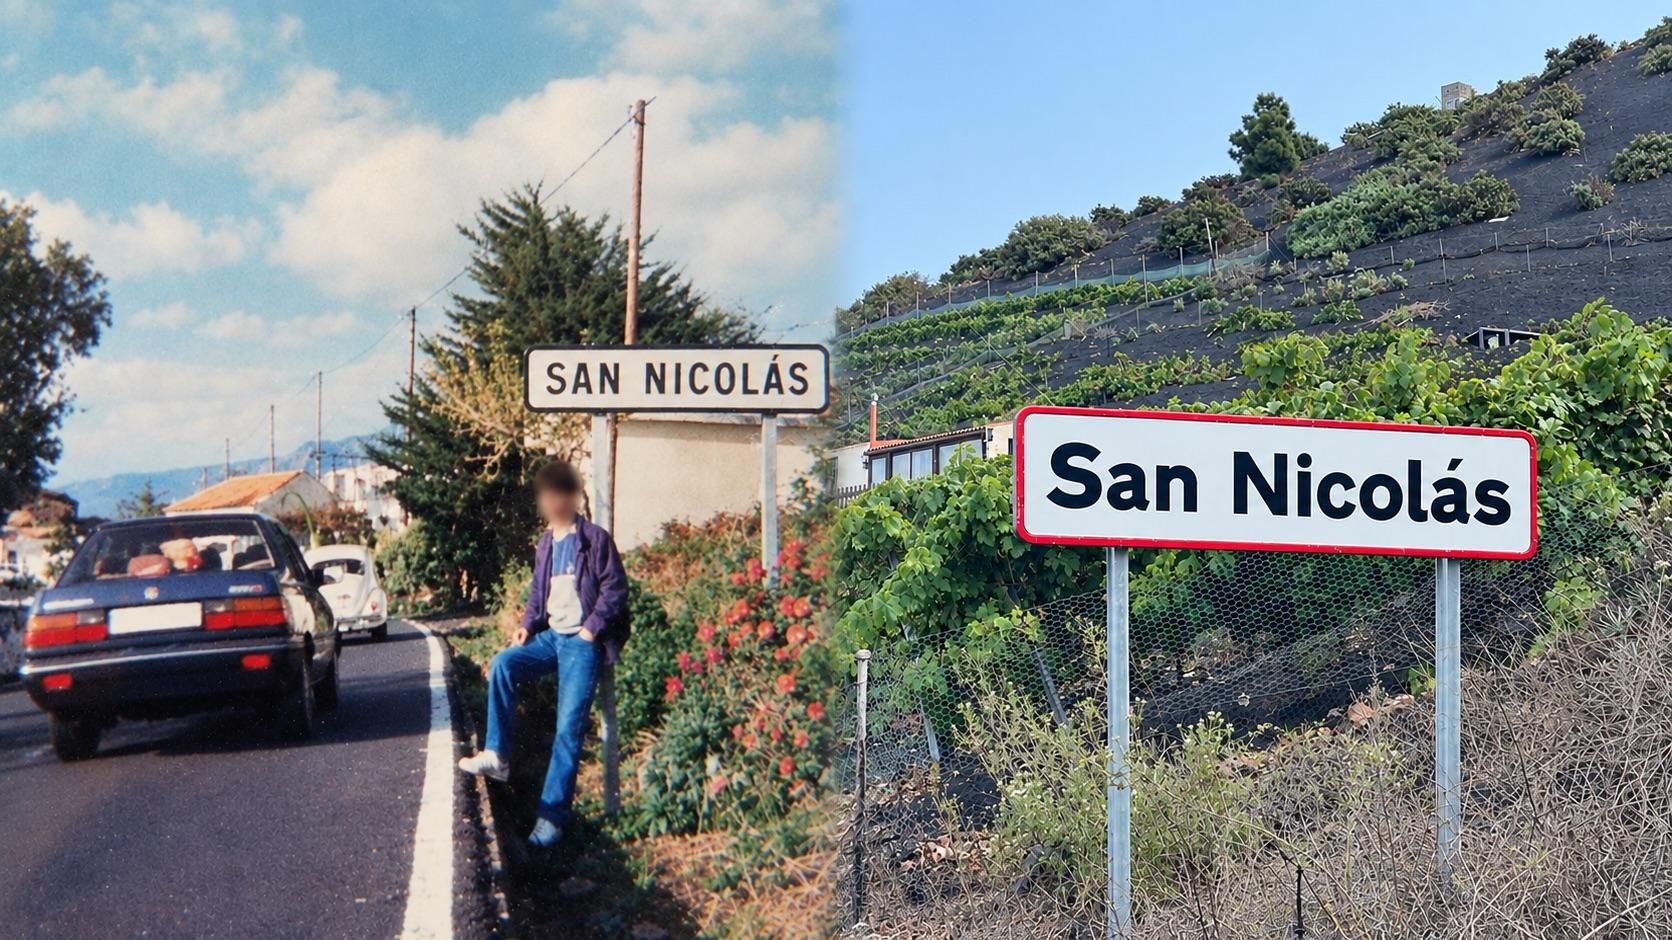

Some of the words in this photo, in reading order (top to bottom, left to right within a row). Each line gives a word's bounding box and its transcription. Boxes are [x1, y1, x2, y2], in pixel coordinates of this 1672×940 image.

[546, 362, 620, 395] SAN
[645, 354, 809, 395] NICOLÁS
[1046, 442, 1198, 513] San
[1233, 451, 1512, 526] Nicolás
